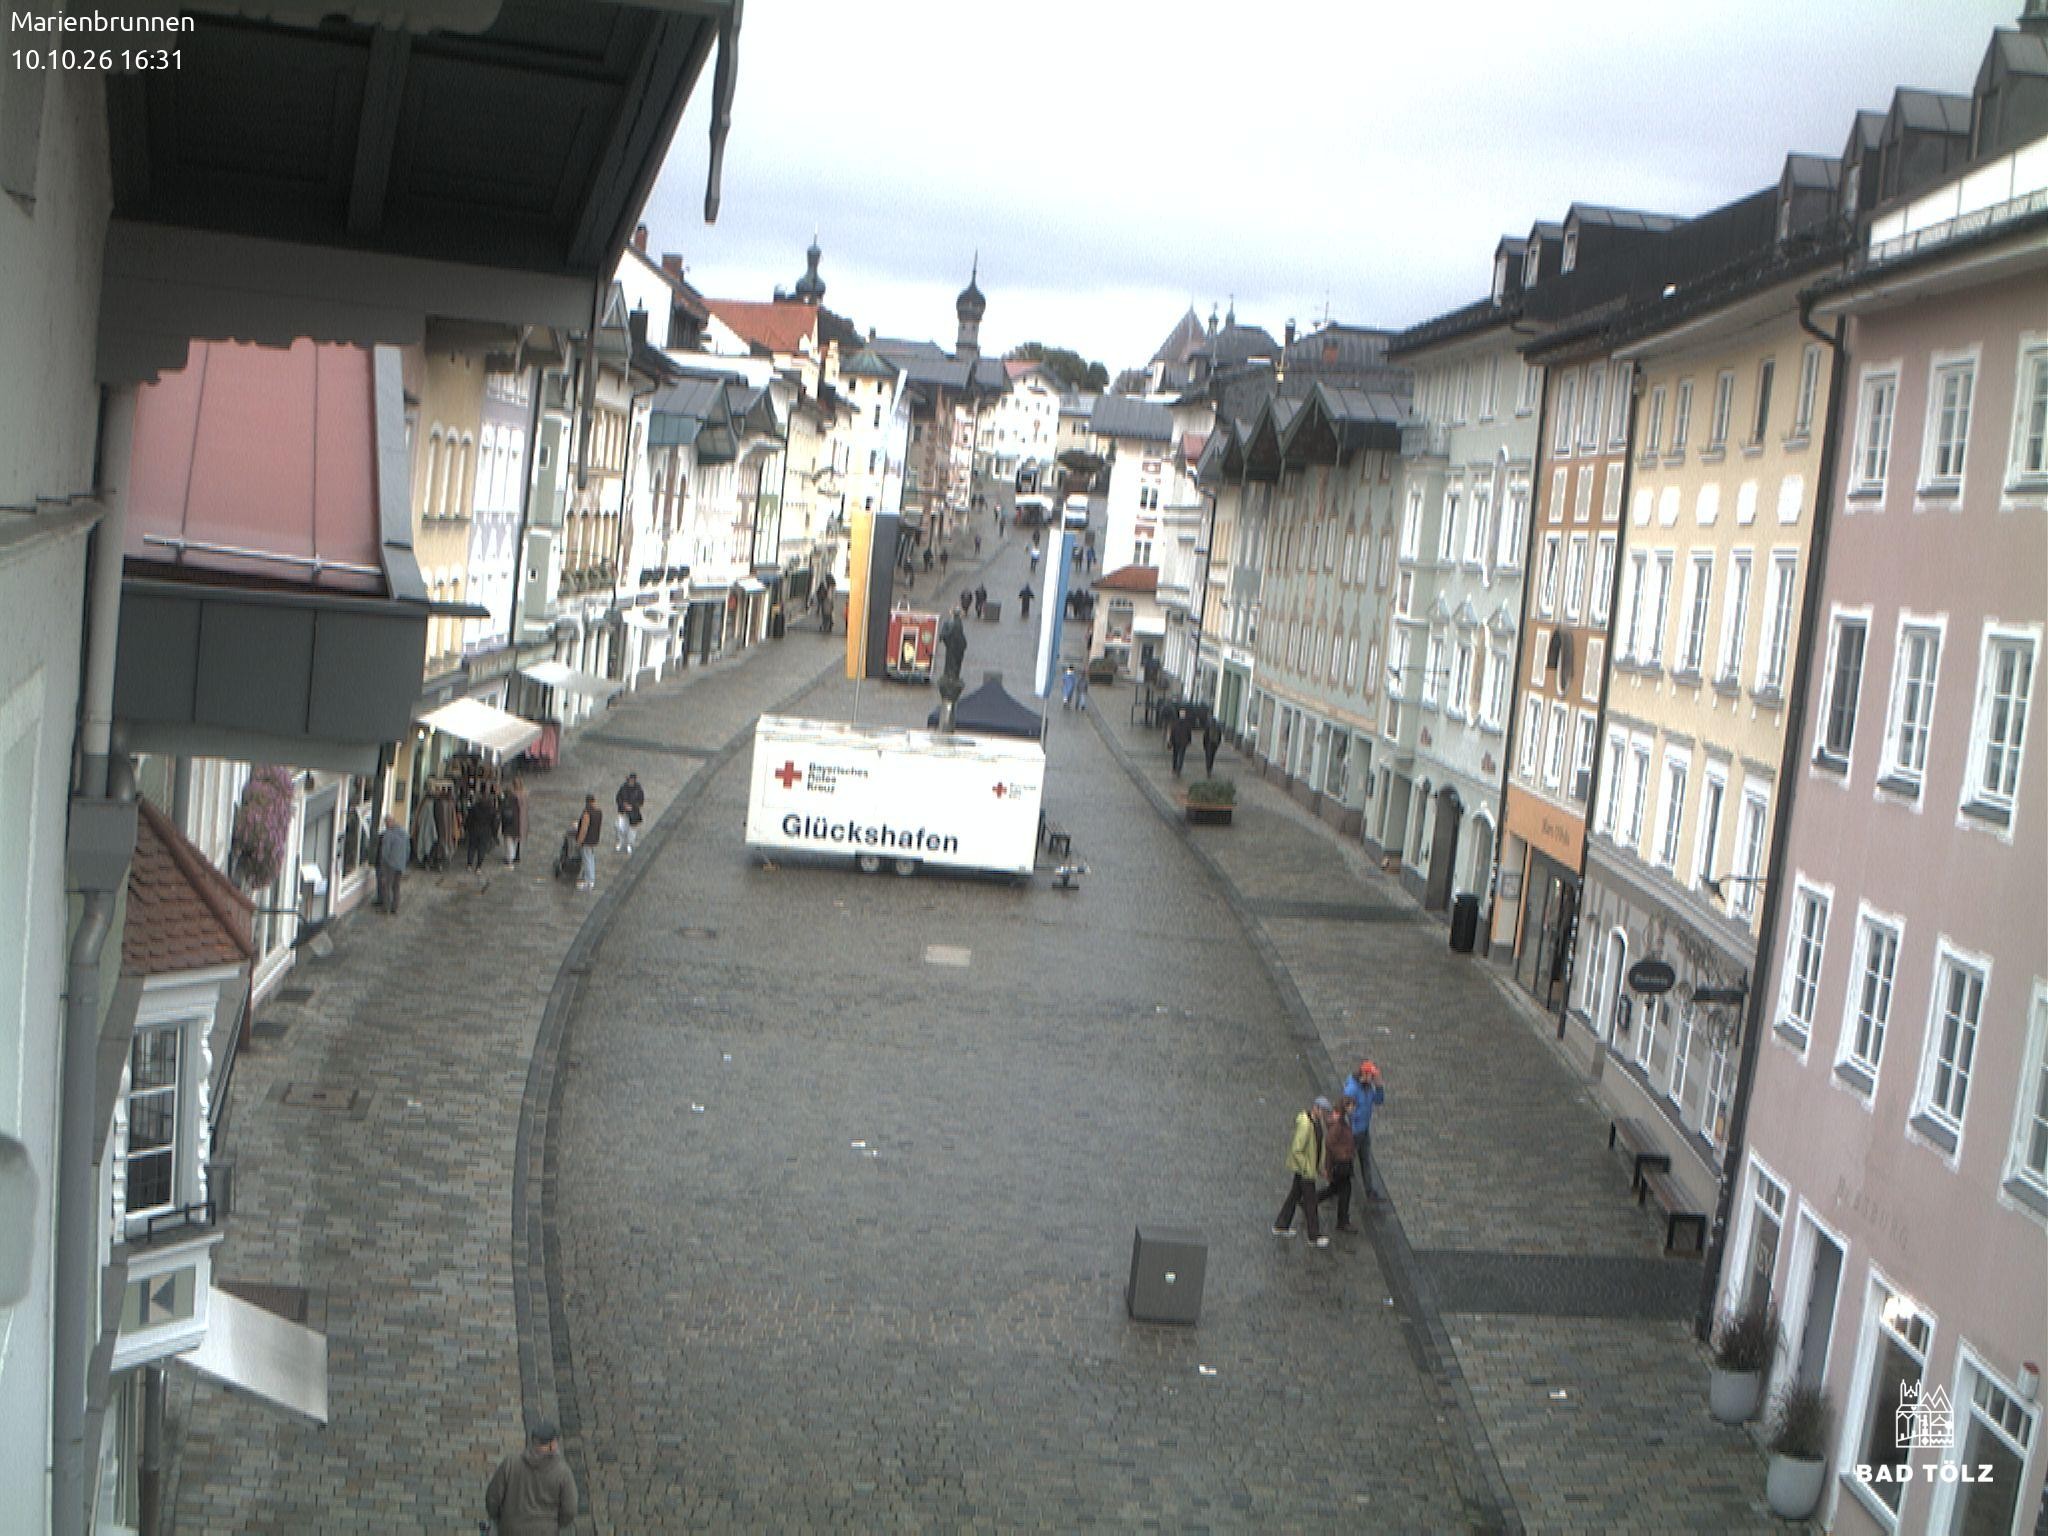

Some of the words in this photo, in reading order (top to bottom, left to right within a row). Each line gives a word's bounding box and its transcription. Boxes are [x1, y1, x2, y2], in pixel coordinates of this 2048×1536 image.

[808, 771, 837, 783] Rotes
[809, 762, 869, 778] Bayerisches
[807, 783, 836, 794] Kreuz
[782, 813, 958, 854] Glückshafen
